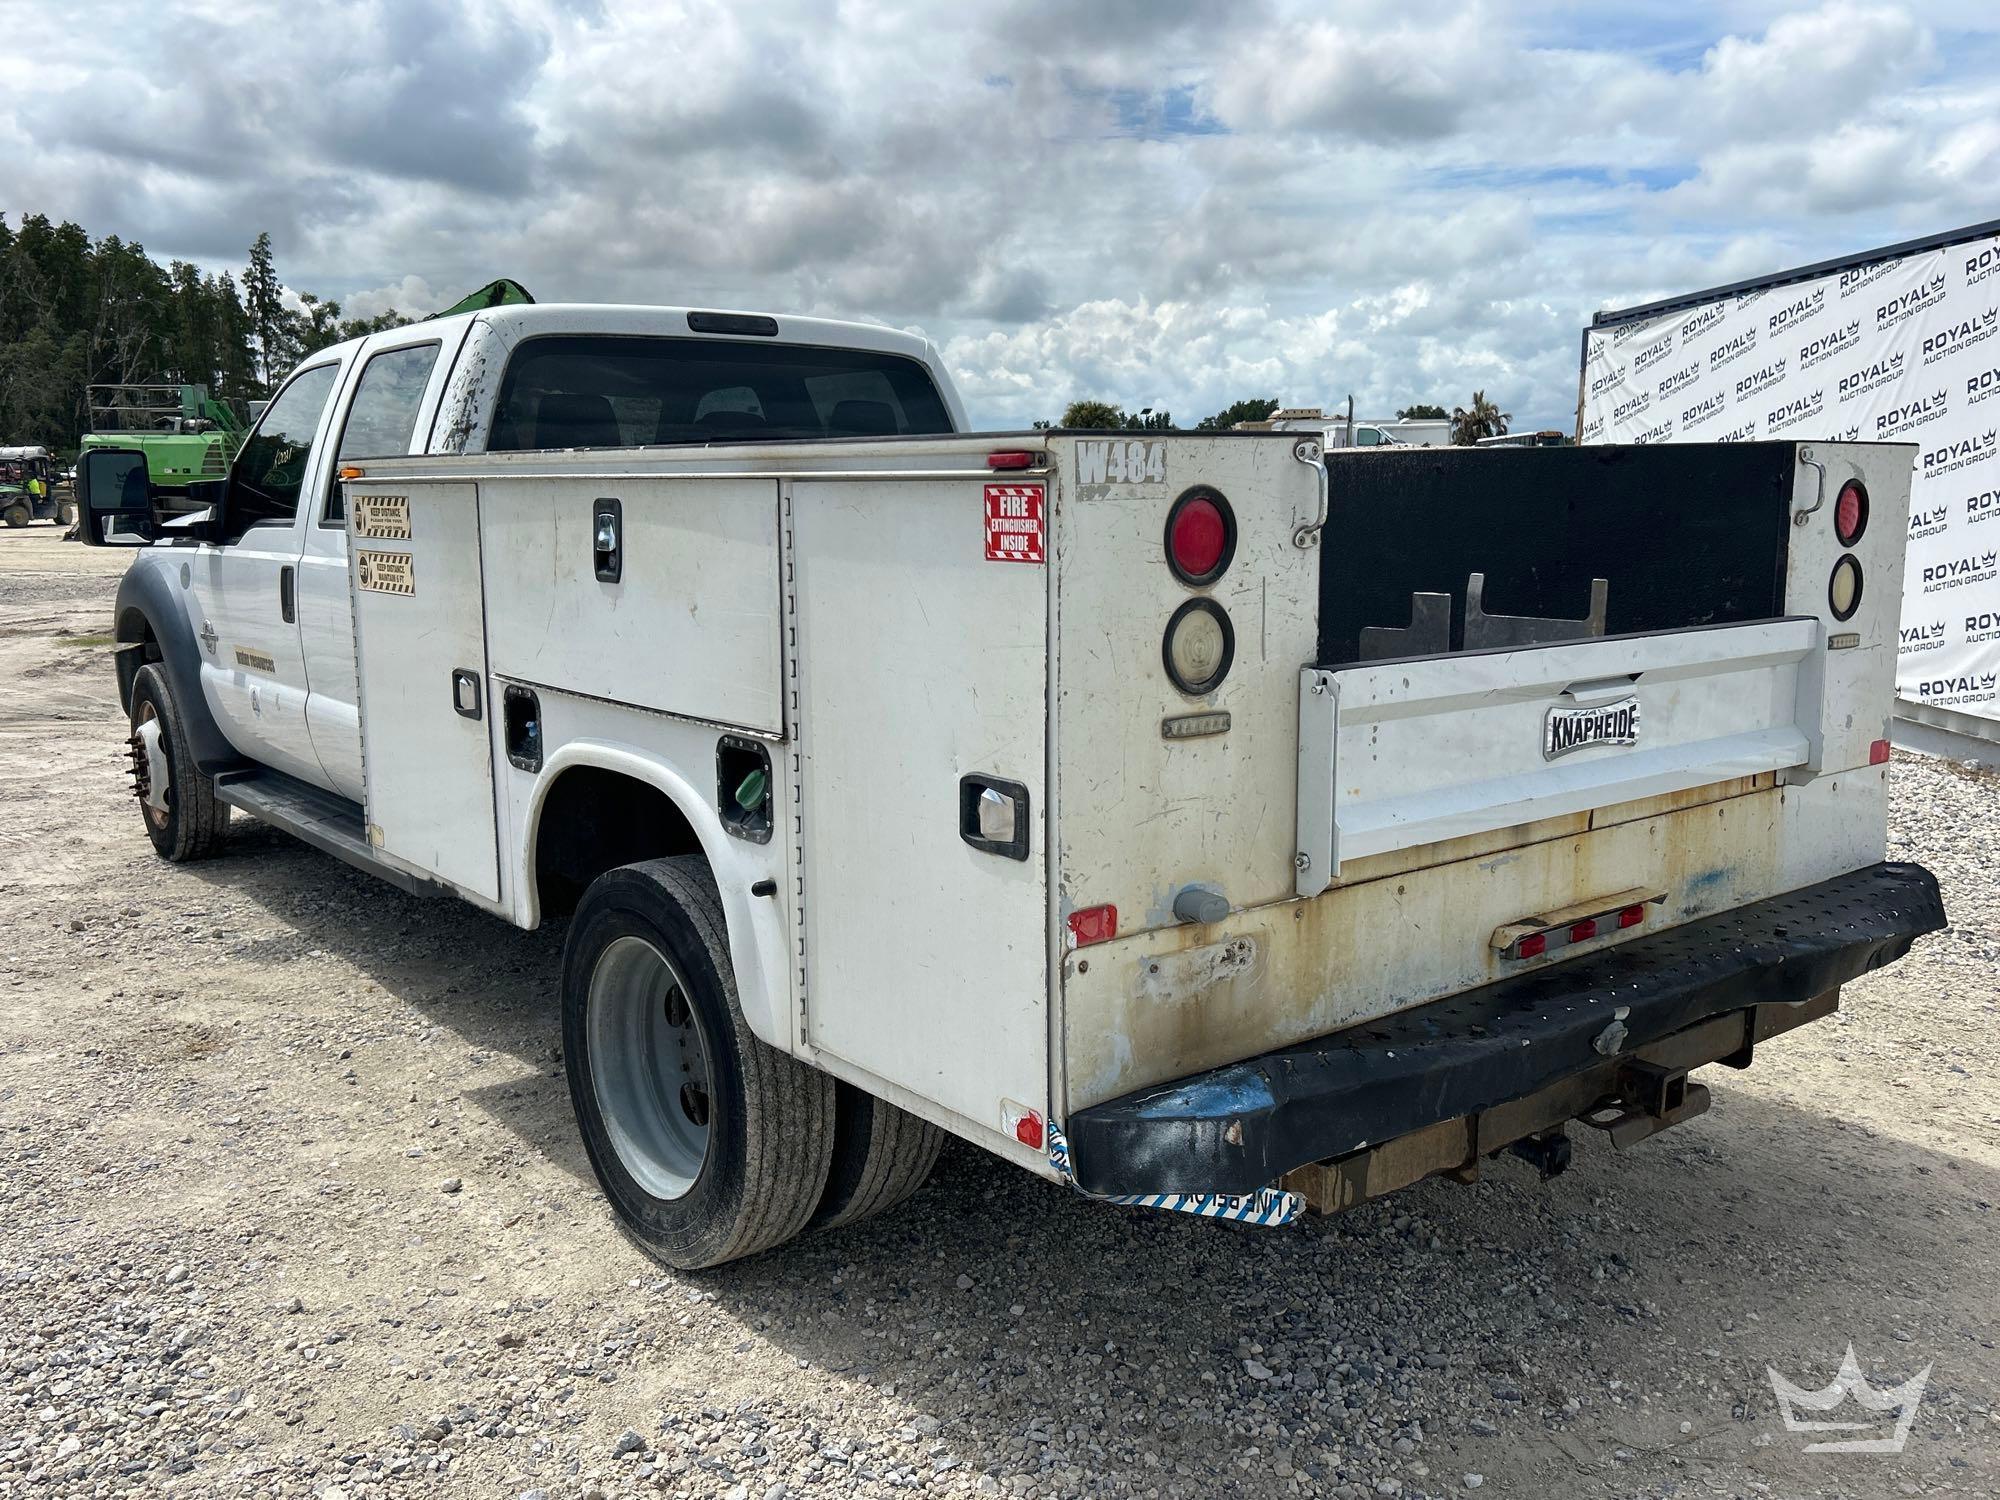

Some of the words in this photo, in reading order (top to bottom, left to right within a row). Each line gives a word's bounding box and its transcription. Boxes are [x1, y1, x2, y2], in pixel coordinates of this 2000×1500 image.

[1966, 247, 2000, 275] ROY
[1840, 274, 1874, 299] AUCTION
[1875, 259, 1903, 279] GROUP
[1967, 263, 2000, 287] AUCTIO
[1770, 297, 1812, 329] ROYAL
[1877, 285, 1930, 322] ROYAL
[1877, 308, 1914, 332] AUCTION
[1915, 292, 1946, 313] GROUP
[1682, 309, 1716, 338] ROYAL
[1770, 318, 1799, 338] AUCTION
[1800, 303, 1824, 322] GROUP
[1682, 328, 1706, 346] AUCTION
[1710, 335, 1746, 363] ROYAL
[1800, 329, 1846, 361] ROYAL
[1923, 318, 1982, 355] ROYAL
[1923, 342, 1964, 366] AUCTION
[1965, 326, 1998, 347] GROUP
[1634, 342, 1664, 367] ROYAL
[1711, 354, 1734, 372] AUCTION
[1735, 341, 1756, 358] GROUP
[1800, 349, 1832, 371] AUCTION
[1833, 336, 1860, 355] GROUP
[1592, 371, 1617, 393] ROYAL
[1659, 368, 1690, 394] ROYAL
[1736, 366, 1775, 394] ROYAL
[1737, 385, 1763, 403] AUCTION
[1763, 373, 1786, 390] GROUP
[1839, 361, 1890, 393] ROYAL
[1839, 382, 1874, 403] AUCTION
[1875, 369, 1904, 388] GROUP
[1967, 368, 2000, 394] ROY
[1660, 386, 1681, 401] AUCTION
[1968, 385, 2000, 406] AUCTIO
[1614, 396, 1641, 419] ROYAL
[1682, 397, 1716, 423] ROYAL
[1768, 397, 1811, 425] ROYAL
[1768, 416, 1797, 435] AUCTION
[1797, 405, 1823, 421] GROUP
[1877, 398, 1932, 431] ROYAL
[1584, 421, 1598, 435] YAL
[1635, 426, 1664, 444] ROYAL
[1683, 416, 1705, 431] AUCTION
[1877, 421, 1915, 441] AUCTION
[1916, 407, 1948, 426] GROUP
[1077, 440, 1166, 483] W484
[1924, 437, 1982, 469] ROYAL
[1924, 460, 1964, 480] AUCTION
[1966, 448, 1997, 466] GROUP
[1000, 496, 1029, 517] FIRE
[1967, 490, 2000, 513] ROY
[991, 518, 1038, 533] EXTINGUISHER
[1967, 508, 2000, 525] AUCTIO
[1000, 535, 1029, 551] INSIDE
[1917, 524, 1948, 539] GROUP
[1923, 557, 1981, 582] ROYAL
[1924, 578, 1963, 594] AUCTION
[1965, 570, 1997, 585] GROUP
[1900, 626, 1930, 643] YAL
[1966, 613, 2000, 632] ROY
[1914, 640, 1945, 652] GROUP
[1966, 631, 2000, 644] AUCTIO
[1920, 677, 1979, 696] ROYAL
[1962, 693, 1996, 703] GROUP
[1551, 704, 1637, 752] KNAPHEIDE
